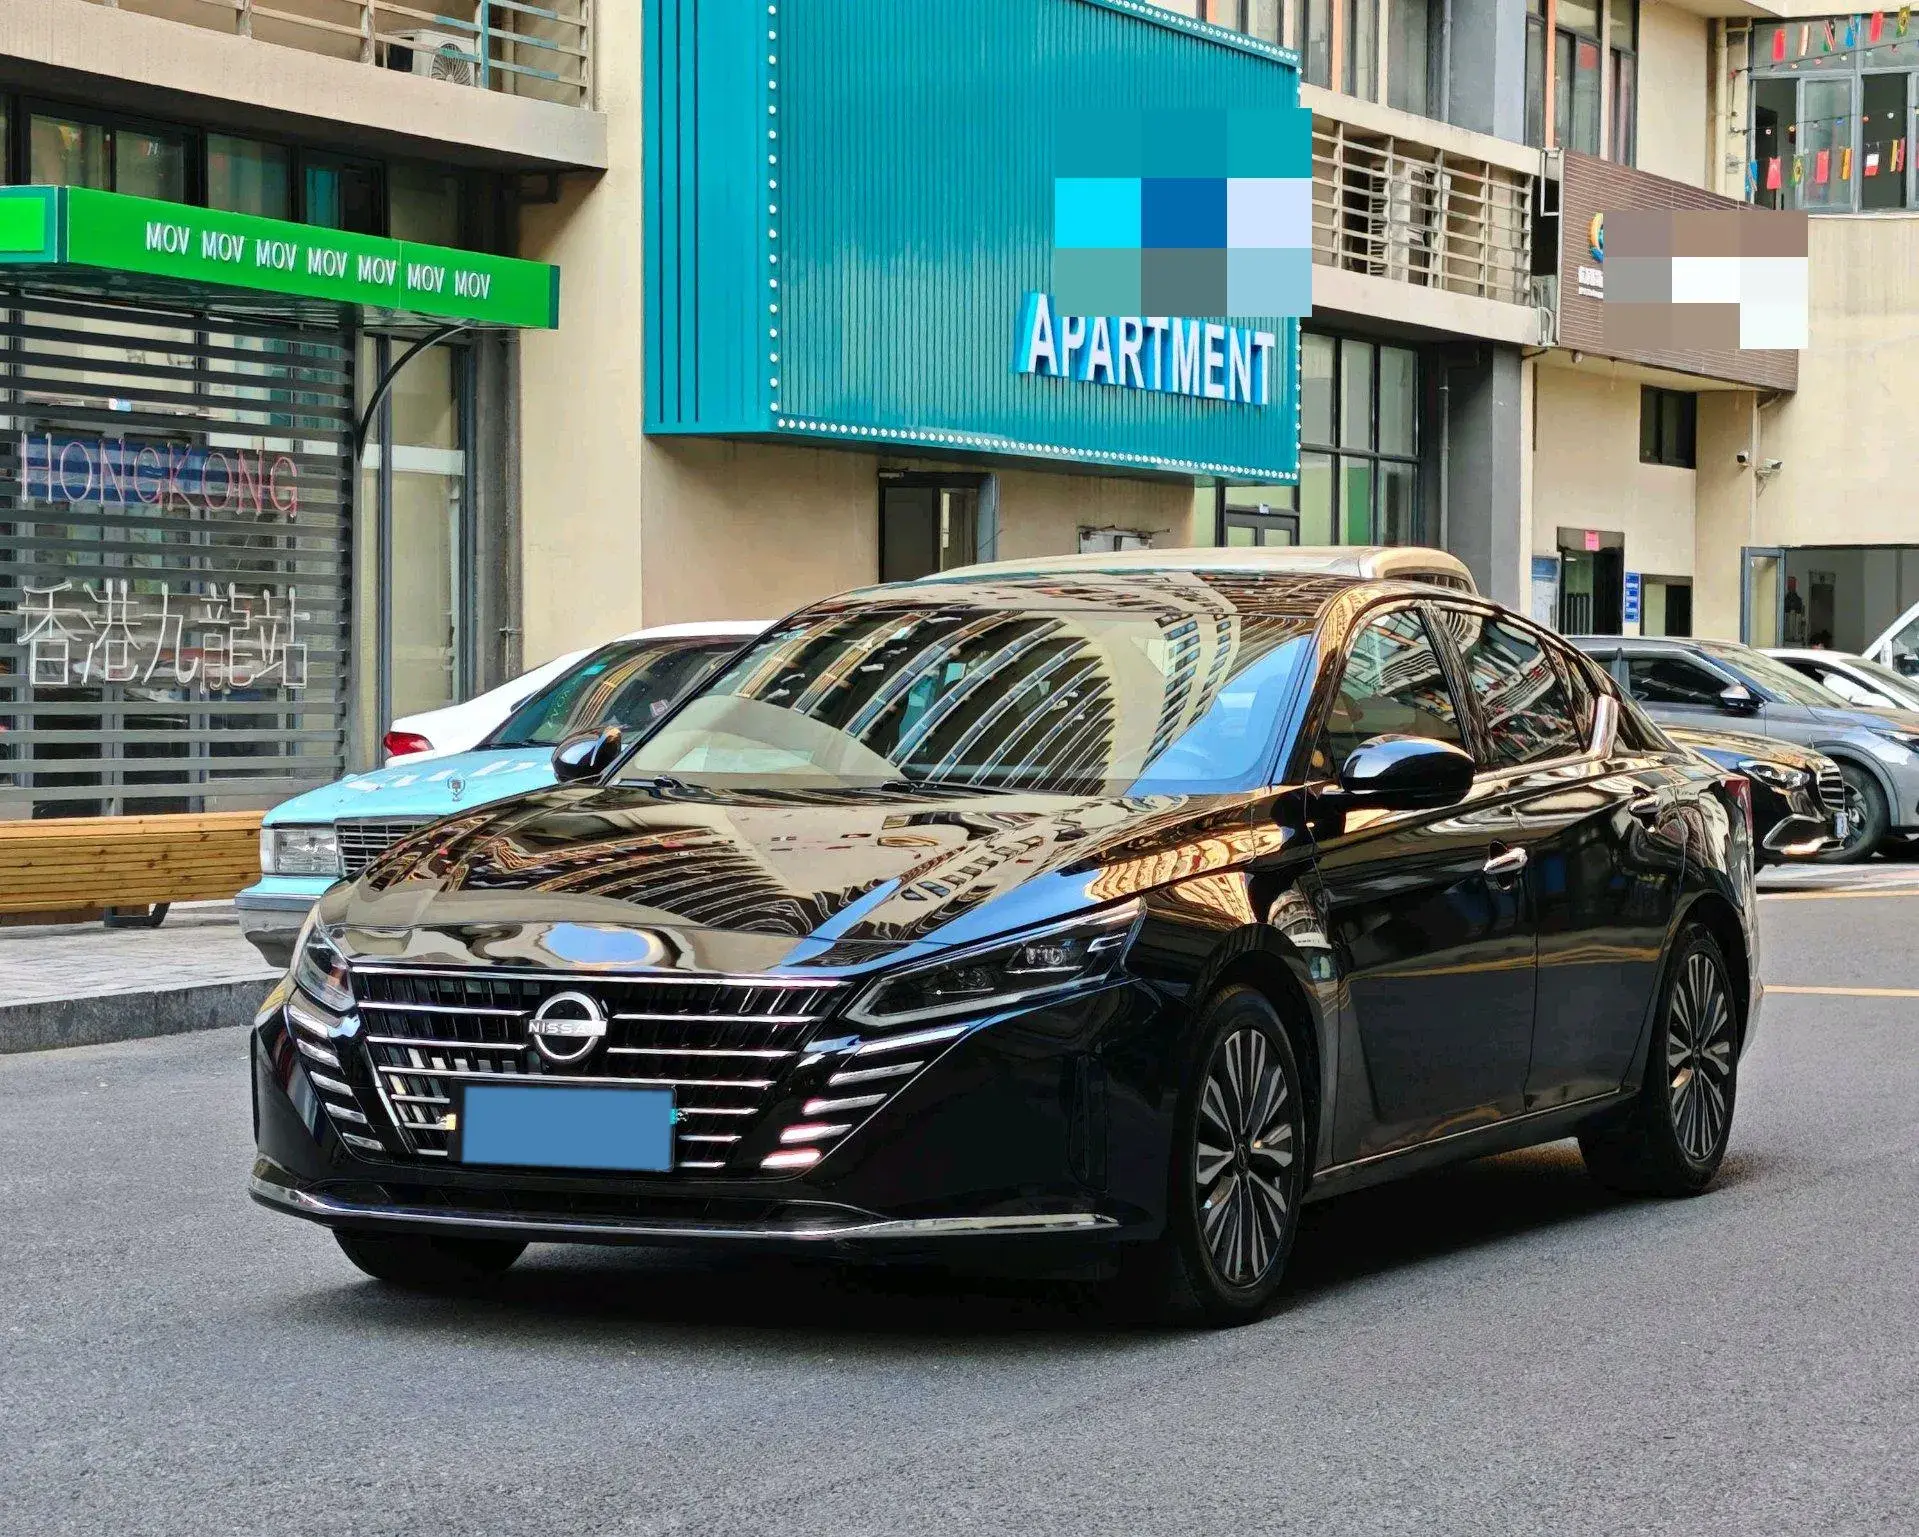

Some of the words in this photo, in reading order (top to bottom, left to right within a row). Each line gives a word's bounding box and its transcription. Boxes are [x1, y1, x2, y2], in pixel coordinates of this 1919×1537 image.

[146, 221, 190, 255] MOV
[202, 230, 245, 263] MOV
[256, 239, 297, 271] MOV
[308, 247, 348, 278] MOV
[358, 255, 396, 286] MOV
[407, 263, 445, 293] MOV
[454, 270, 491, 300] MOV
[1018, 292, 1275, 405] APARTMENT
[21, 432, 299, 518] HONGKONG
